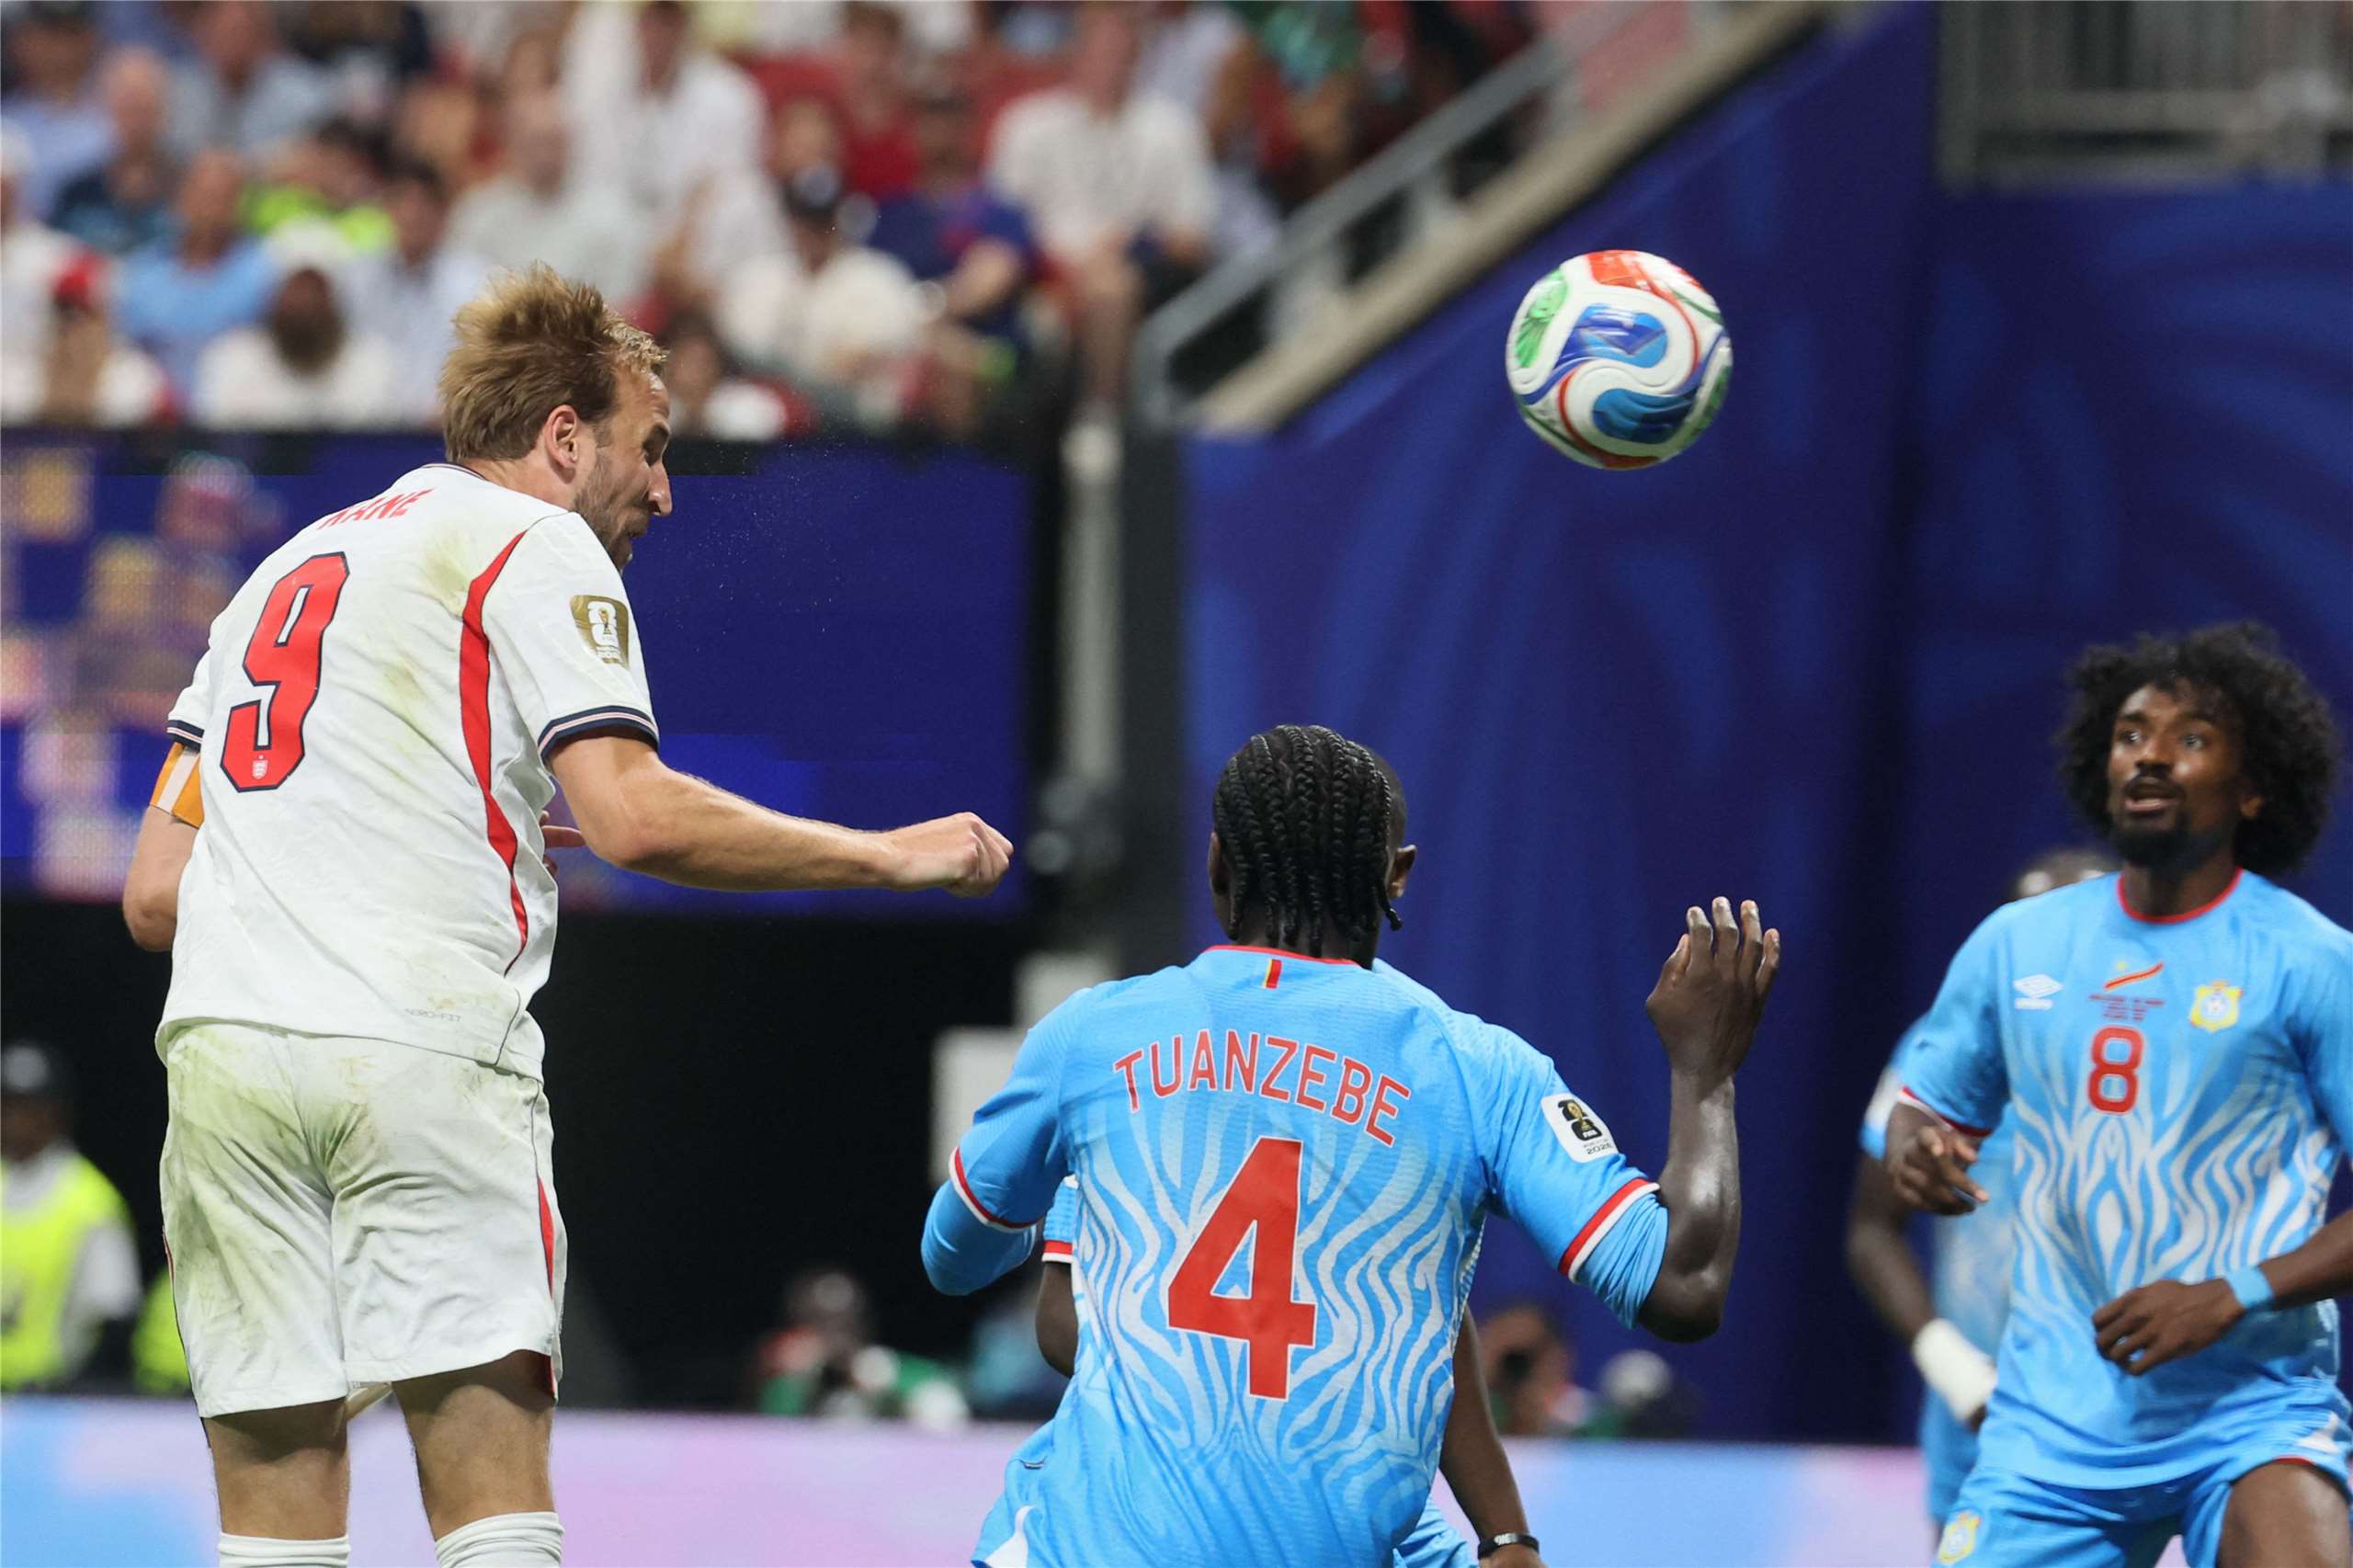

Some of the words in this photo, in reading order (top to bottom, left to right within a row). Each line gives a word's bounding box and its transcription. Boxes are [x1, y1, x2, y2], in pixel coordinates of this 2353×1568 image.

[221, 551, 350, 792] 9
[1112, 1028, 1412, 1148] TUANZEBE
[2086, 1024, 2145, 1115] 8
[1166, 1135, 1317, 1402] 4
